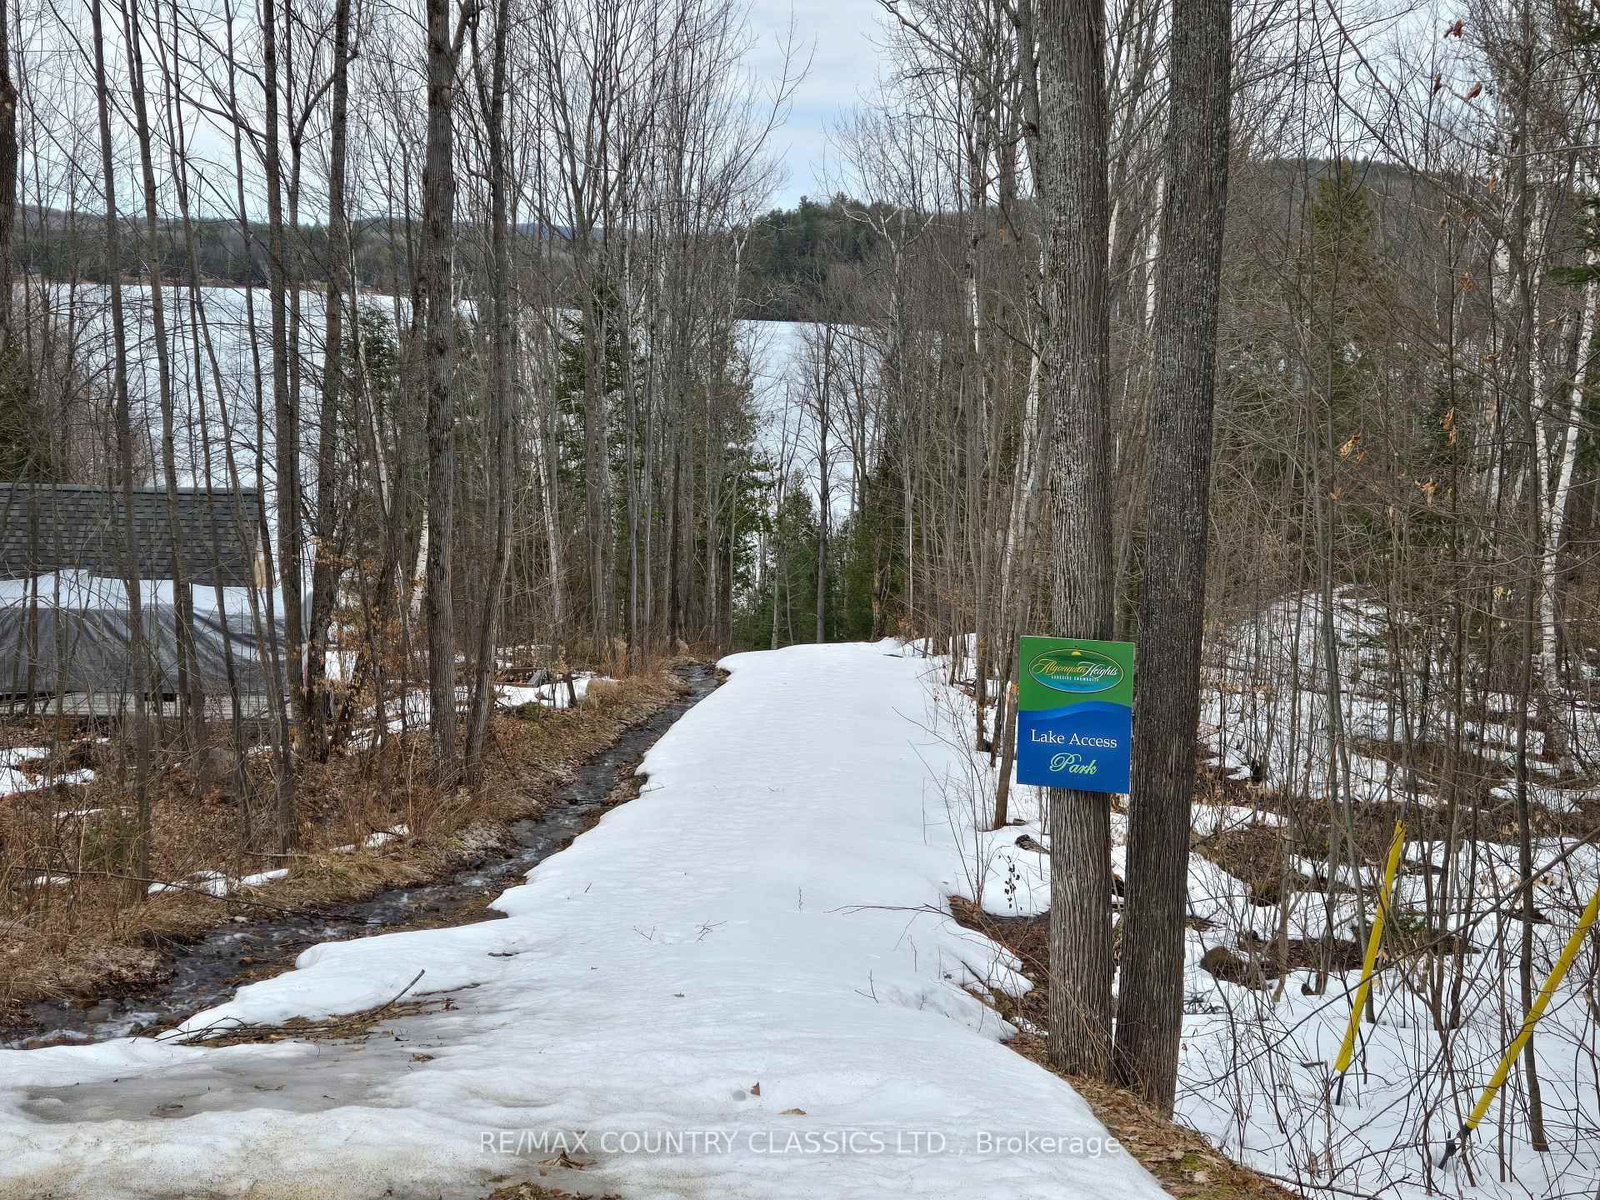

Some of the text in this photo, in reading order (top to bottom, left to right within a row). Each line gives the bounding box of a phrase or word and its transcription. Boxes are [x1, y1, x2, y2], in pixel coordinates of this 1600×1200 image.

[1078, 661, 1118, 679] Heights
[1031, 728, 1118, 749] Lake Access
[1049, 752, 1098, 775] Park
